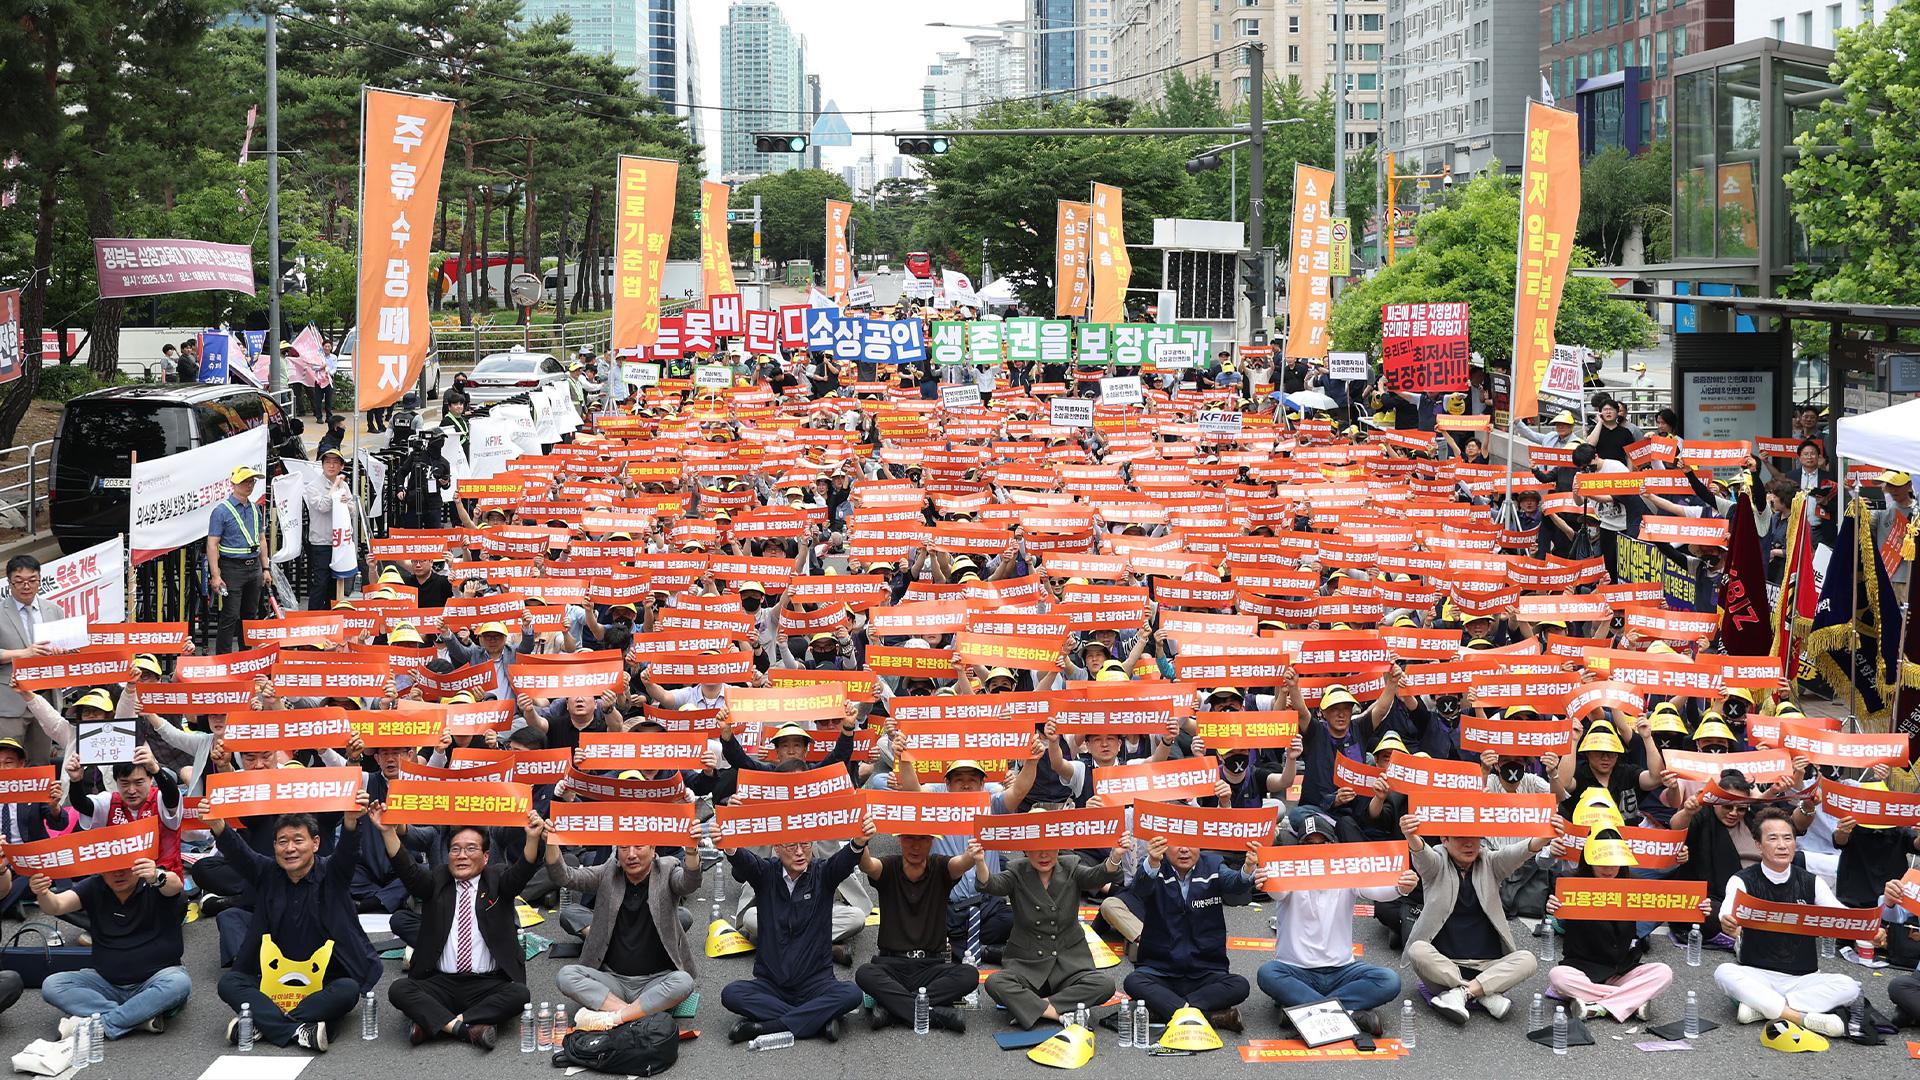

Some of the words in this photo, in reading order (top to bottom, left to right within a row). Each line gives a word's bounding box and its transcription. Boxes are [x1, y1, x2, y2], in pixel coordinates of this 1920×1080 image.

[1526, 128, 1551, 297] 최저임금
[623, 168, 648, 299] 근로기준법
[1298, 178, 1318, 274] 소상공인
[1064, 208, 1075, 266] 소상공인
[102, 247, 138, 269] 정부는
[684, 290, 694, 300] kt
[1387, 304, 1409, 321] 피곤에
[684, 315, 711, 349] 못
[808, 311, 922, 362] 소상공인
[935, 318, 1068, 361] 생존권을
[1383, 321, 1411, 338] 5인미만
[1412, 320, 1428, 337] 힘든
[1384, 339, 1413, 359] 우리도!!
[1413, 341, 1467, 362] 최저시급
[1386, 359, 1469, 390] 보장하라!!!
[1200, 411, 1242, 423] KFME
[136, 506, 158, 525] 외식업
[158, 502, 172, 521] 현실
[734, 522, 764, 531] 생존권을
[1645, 524, 1678, 534] 생존권을
[1680, 526, 1724, 537] 보장하라!!
[372, 545, 403, 554] 생존권을
[935, 536, 967, 547] 생존권을
[712, 563, 747, 575] 생존권을
[795, 584, 832, 594] 생존권을
[247, 629, 286, 639] 생존권을
[290, 624, 339, 637] 보장하라!!
[662, 617, 700, 629] 생존권을
[974, 623, 1013, 636] 생존권을
[1628, 615, 1667, 630] 생존권을
[1668, 620, 1715, 632] 보장하라!!
[128, 633, 183, 644] 보장하라!!
[182, 665, 227, 677] 생존권을
[230, 653, 278, 676] 보장하라!!
[652, 664, 694, 675] 생존권을
[698, 662, 750, 674] 보장하라!!
[870, 656, 912, 667] 고용정책
[16, 666, 65, 680] 생존권을
[69, 661, 128, 675] 보장하라!!
[1181, 666, 1226, 678] 생존권을
[1230, 665, 1286, 677] 보장하라!!
[1612, 667, 1658, 683] 최저임금
[1663, 672, 1722, 689] 구분적용!!
[274, 675, 322, 686] 생존권을
[326, 675, 387, 686] 보장하라!!
[513, 675, 560, 689] 생존권을
[563, 672, 618, 687] 보장하라!!
[140, 693, 188, 706] 생존권을
[192, 692, 252, 704] 보장하라!!
[1475, 684, 1521, 697] 생존권을
[730, 699, 780, 711] 고용정책
[895, 707, 941, 719] 생존권을
[946, 705, 1002, 718] 보장하라!!
[453, 711, 509, 725] 보장하라!!
[1055, 712, 1105, 724] 생존권을
[1110, 711, 1172, 723] 보장하라!!
[224, 724, 279, 739] 생존권을
[285, 719, 352, 737] 보장하라!!
[1195, 724, 1242, 738] 고용정책
[1246, 723, 1299, 736] 전환하라!!
[1465, 728, 1513, 744] 생존권을
[1518, 732, 1569, 745] 보장하라!!
[906, 734, 960, 748] 생존권을
[965, 733, 1030, 747] 보장하라!!
[1784, 736, 1834, 751] 생존권을
[1838, 744, 1903, 757] 보장하라!!
[584, 745, 635, 758] 생존권을
[640, 745, 705, 757] 보장하라!!
[1097, 777, 1149, 794] 생존권을
[1151, 769, 1219, 789] 보장하라!!
[1337, 766, 1377, 790] 생존권을
[1385, 764, 1428, 785] 생존권을
[1433, 773, 1482, 790] 보장하라!!
[210, 784, 271, 804] 생존권을
[277, 781, 355, 798] 보장하라!!
[388, 795, 449, 810] 고용정책
[455, 796, 528, 812] 전환하라!!
[1825, 791, 1882, 814] 생존권을
[553, 816, 613, 831] 생존권을
[619, 816, 691, 832] 보장하라!!
[720, 817, 782, 835] 생존권을
[788, 809, 861, 829] 보장하라!!
[1414, 807, 1474, 824] 생존권을
[1480, 808, 1554, 823] 보장하라!!
[981, 825, 1040, 840] 생존권을
[1045, 820, 1118, 837] 보장하라!!
[1140, 814, 1198, 834] 생존권을
[1203, 822, 1271, 837] 보장하라!!
[14, 849, 74, 868] 생존권을
[78, 832, 155, 857] 보장하라!!
[1262, 860, 1325, 879] 생존권을
[1330, 856, 1403, 874] 보장하라!!
[1562, 892, 1621, 907] 고용정책
[1627, 893, 1702, 909] 전환하라!!
[1736, 903, 1800, 924] 생존권을
[1803, 909, 1881, 931] 보장하라!!
